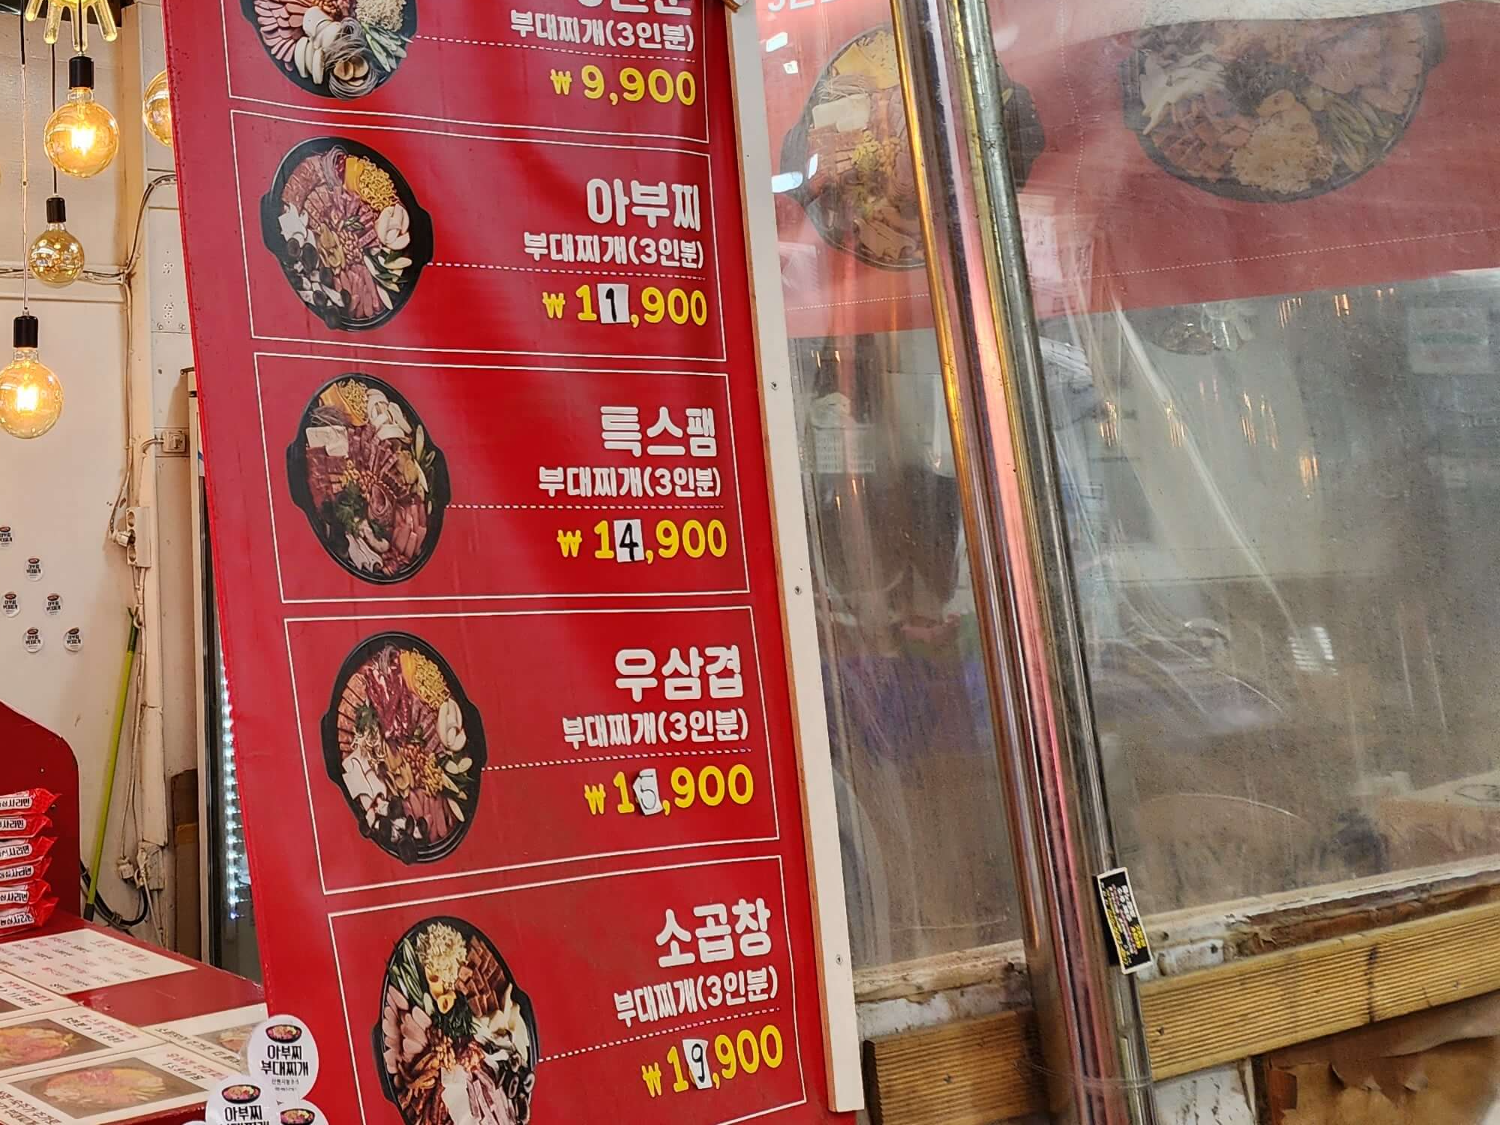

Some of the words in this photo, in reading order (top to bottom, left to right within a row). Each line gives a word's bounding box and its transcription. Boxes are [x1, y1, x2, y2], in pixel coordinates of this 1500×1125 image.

[510, 9, 695, 53] 부대찌개(3인분)
[580, 64, 697, 107] 9,900
[585, 177, 701, 232] 아부찌
[523, 231, 704, 270] 부대찌개(3인분)
[575, 283, 708, 329] 11,900
[600, 405, 718, 458] 특스팸
[538, 466, 721, 498] 부대찌개(3인분)
[593, 518, 728, 565] 14,900
[614, 644, 745, 703] 우삼겹
[561, 707, 750, 751] 부대찌개(3인분)
[655, 896, 772, 968] 소곱창
[612, 966, 780, 1028] 부대찌개(3인분)
[260, 1060, 309, 1077] 부대찌개
[266, 1044, 303, 1060] 아부찌
[667, 1023, 784, 1095] 19,900
[224, 1105, 263, 1122] 아부찌
